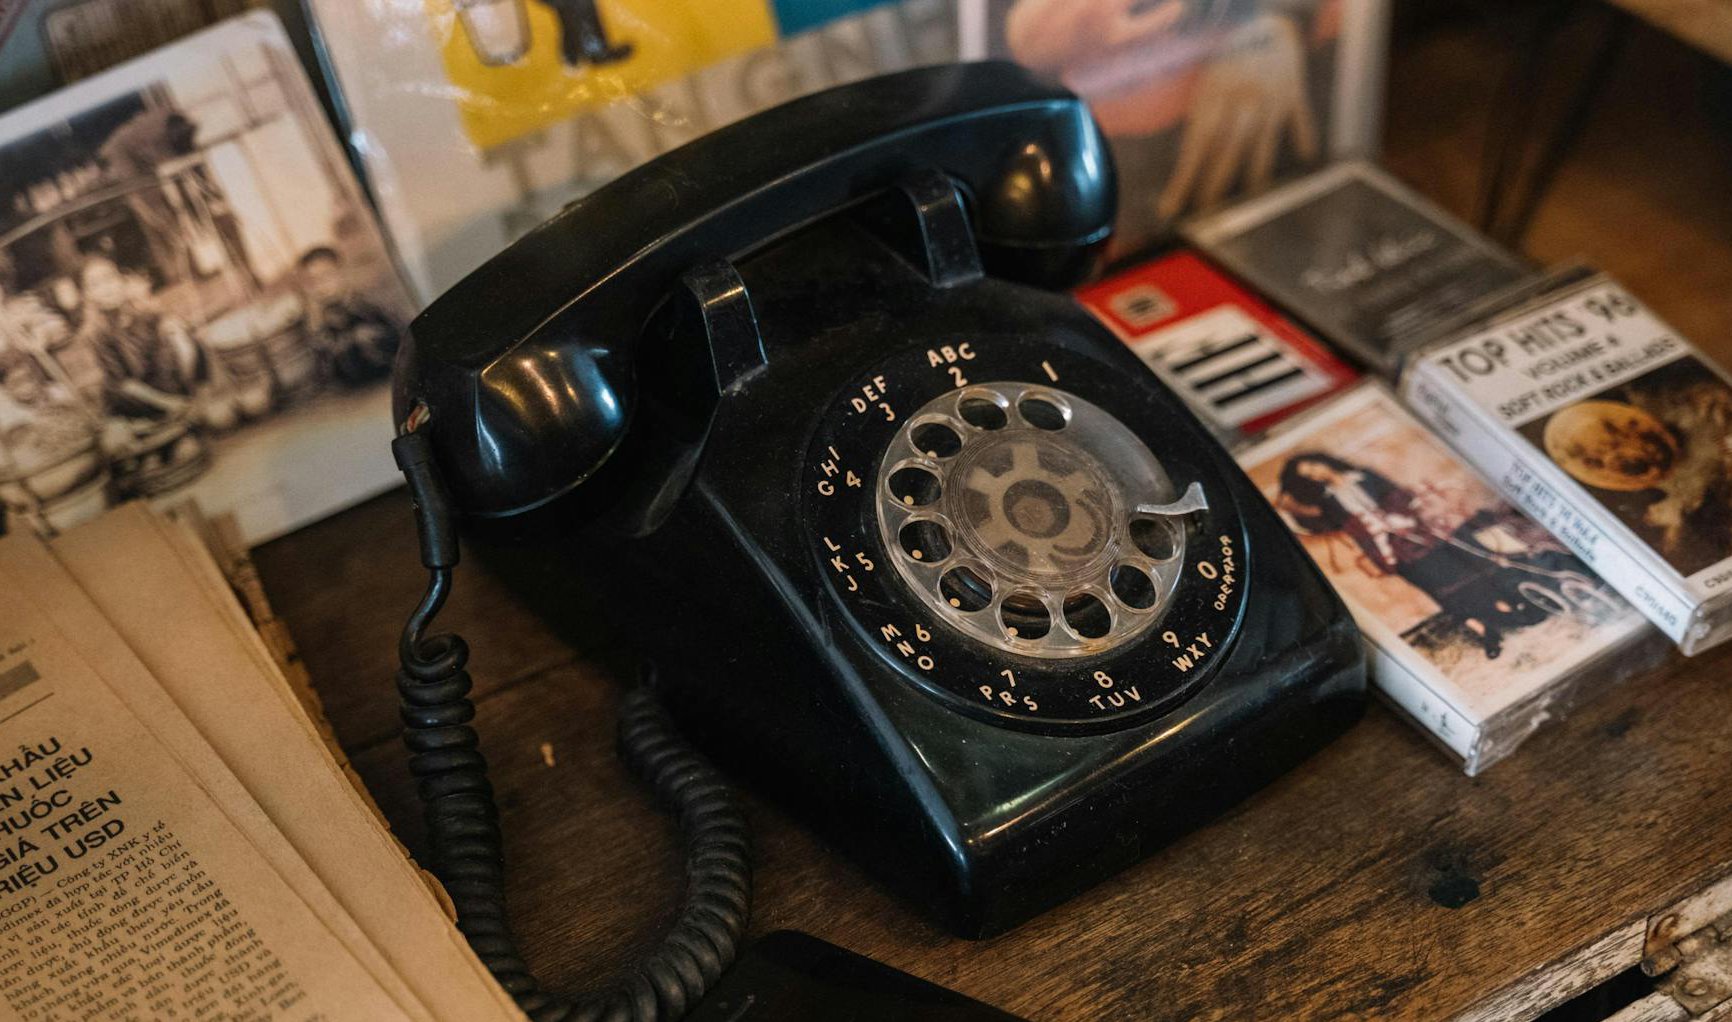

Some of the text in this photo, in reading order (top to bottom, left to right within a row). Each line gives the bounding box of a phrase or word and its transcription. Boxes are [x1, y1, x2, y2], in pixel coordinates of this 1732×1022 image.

[926, 342, 976, 368] ABC
[1439, 338, 1508, 383] TOP
[1507, 311, 1586, 355] HITS
[1524, 340, 1604, 379] VOLUME
[850, 375, 888, 414] DEF
[948, 366, 969, 388] 2
[878, 402, 897, 423] 3
[1498, 391, 1539, 419] SOFT
[846, 470, 863, 489] 4
[855, 551, 875, 572] 5
[1213, 534, 1236, 612] OPERATOR
[915, 623, 932, 643] 6
[1162, 630, 1180, 649] 9
[1171, 631, 1213, 674] WXY
[999, 669, 1018, 688] 7
[1088, 685, 1142, 711] TUV
[1093, 670, 1114, 690] 8
[0, 737, 61, 782] HẨU
[29, 747, 92, 790] LIỆU
[40, 790, 122, 840] TRÊN
[56, 868, 91, 888] Công
[92, 859, 105, 869] ty
[106, 837, 140, 861] XNK
[142, 832, 149, 842] y
[153, 820, 165, 833] tế
[63, 819, 125, 859] USD
[63, 882, 90, 899] hợp
[92, 869, 113, 883] tác
[115, 854, 136, 869] với
[138, 832, 174, 856] nhiều
[89, 885, 108, 899] tại
[110, 871, 129, 885] TP
[134, 857, 155, 873] Hồ
[159, 840, 182, 857] Chí
[167, 870, 206, 897] nguồn
[26, 936, 43, 946] và
[50, 921, 71, 935] các
[134, 868, 156, 887] chế
[160, 851, 190, 870] biến
[67, 918, 103, 940] thuốc
[182, 860, 198, 871] và
[126, 916, 155, 936] theo
[161, 898, 184, 917] yêu
[192, 880, 214, 896] cầu
[100, 942, 137, 966] nhiều
[183, 888, 223, 914] Trong
[139, 910, 212, 955] Vimedimex
